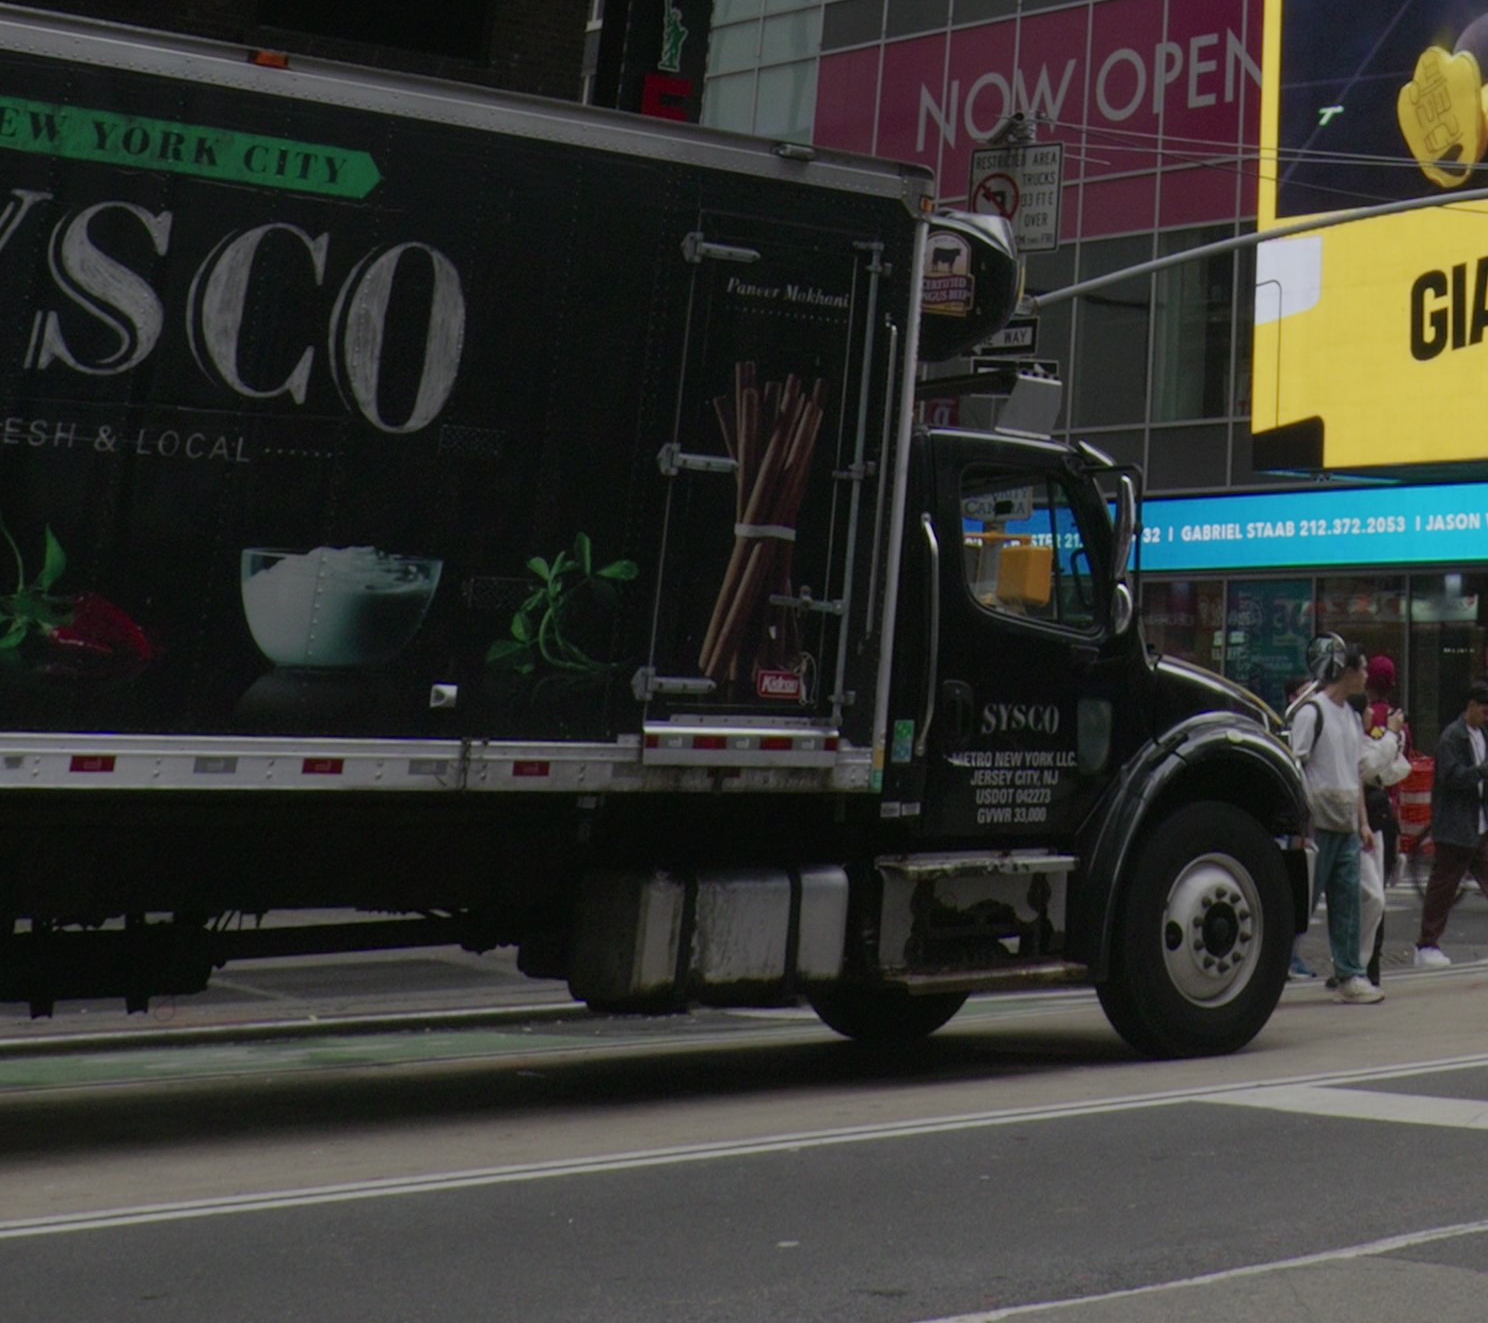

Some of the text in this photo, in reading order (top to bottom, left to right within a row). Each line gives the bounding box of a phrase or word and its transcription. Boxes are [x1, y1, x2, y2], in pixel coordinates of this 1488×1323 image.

[916, 26, 1264, 152] NOW OPEN
[88, 111, 220, 168] YORK
[239, 143, 350, 186] CITY
[1032, 152, 1058, 167] AREA
[1022, 171, 1056, 188] TRUCKS
[1023, 213, 1048, 229] OVER
[727, 275, 851, 309] Paneer Makhani
[923, 290, 948, 302] NGUS
[1004, 329, 1028, 345] WAY
[93, 424, 121, 453] &
[135, 427, 254, 464] LOCAL
[1180, 521, 1244, 542] GABRIEL
[1245, 519, 1296, 539] STAAB
[1298, 515, 1407, 537] 212.372.2053
[1424, 511, 1482, 533] JASON
[980, 702, 1061, 735] SYSCO
[952, 750, 993, 768] METRO
[994, 750, 1024, 768] NEW
[1023, 750, 1055, 767] YORK
[970, 769, 1013, 787] JERSEY
[1042, 769, 1060, 786] NJ
[975, 788, 1015, 805] USDOT
[976, 806, 1013, 825] GVWR
